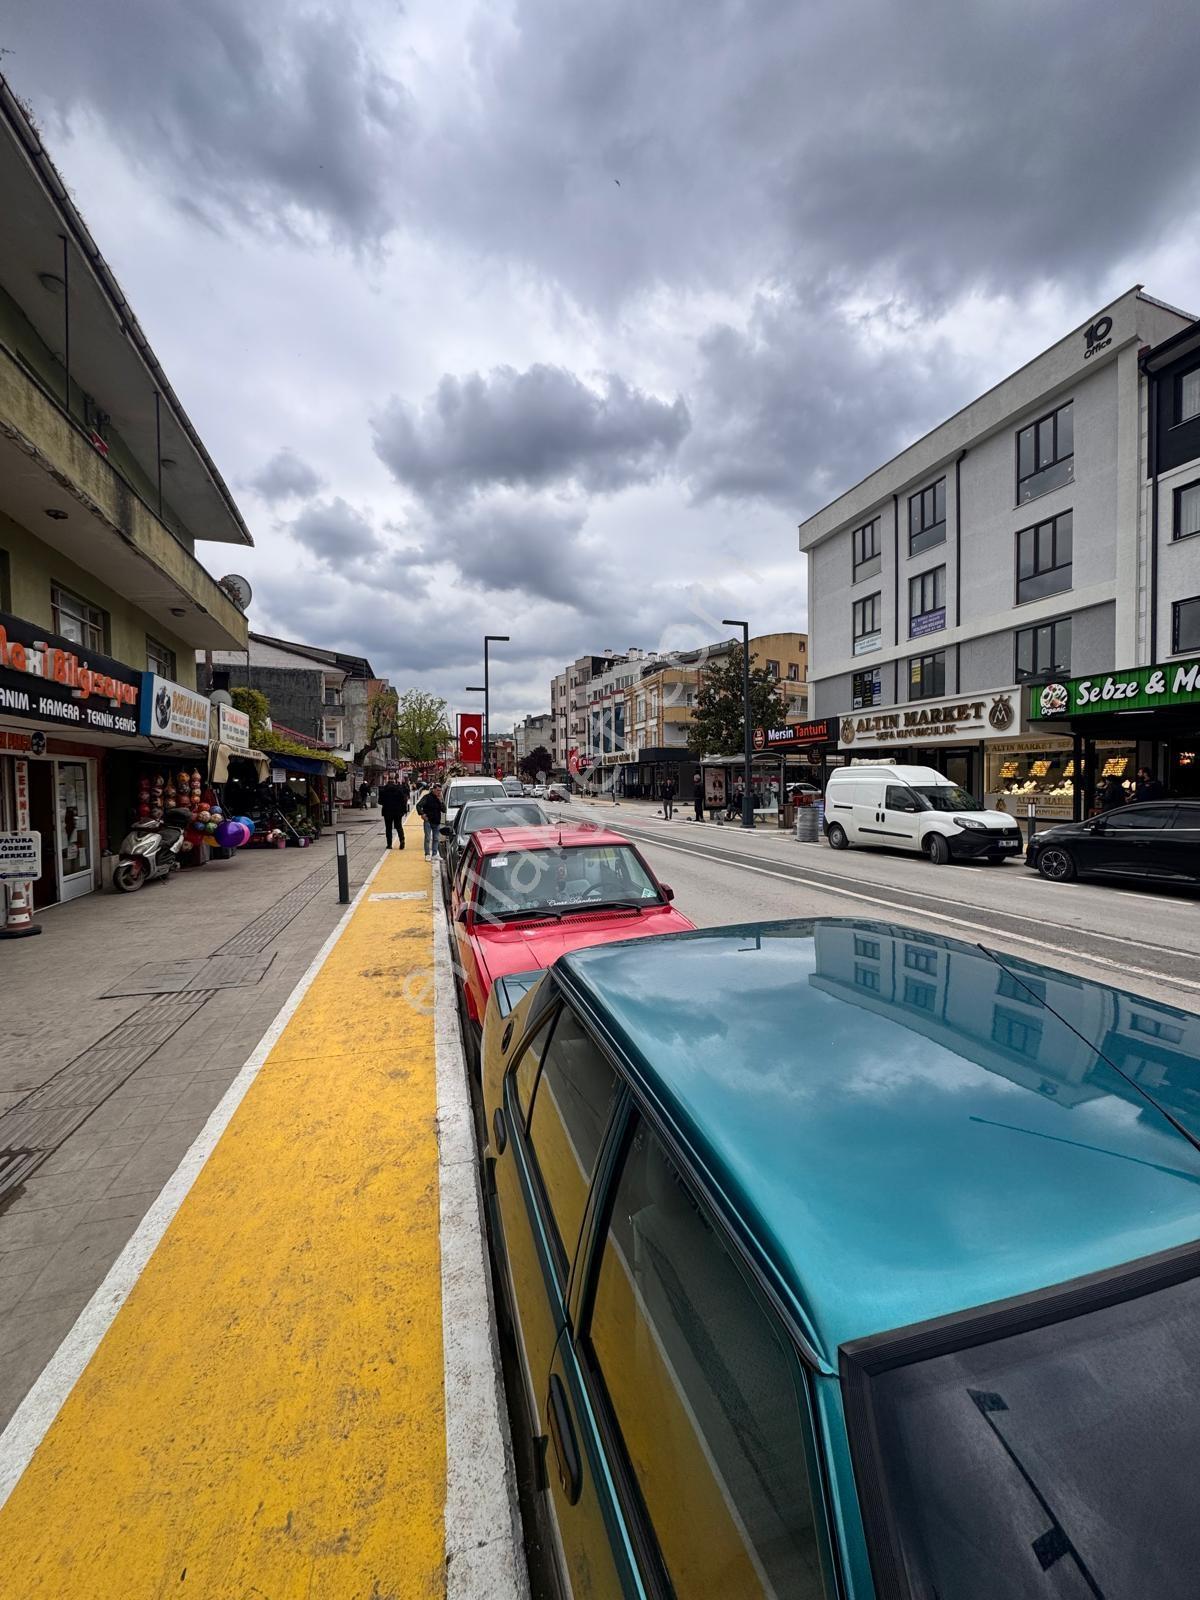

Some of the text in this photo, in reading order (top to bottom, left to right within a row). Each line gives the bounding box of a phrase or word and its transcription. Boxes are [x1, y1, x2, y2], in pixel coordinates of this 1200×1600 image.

[1083, 316, 1112, 349] 10
[1084, 337, 1112, 359] Office
[48, 648, 138, 708] Bilgisayar
[1076, 677, 1139, 706] Sebze
[1144, 670, 1165, 695] &
[39, 697, 80, 721] KAMERA
[87, 708, 114, 728] TEKNİK
[114, 717, 137, 733] SERVİS
[856, 701, 986, 733] ALTIN MARKET
[1041, 706, 1066, 716] Organic
[767, 727, 794, 741] Mersin
[795, 720, 827, 737] Tantuni
[876, 724, 958, 741] SEFA KUYUMCULUK
[992, 743, 1015, 752] ALTIN
